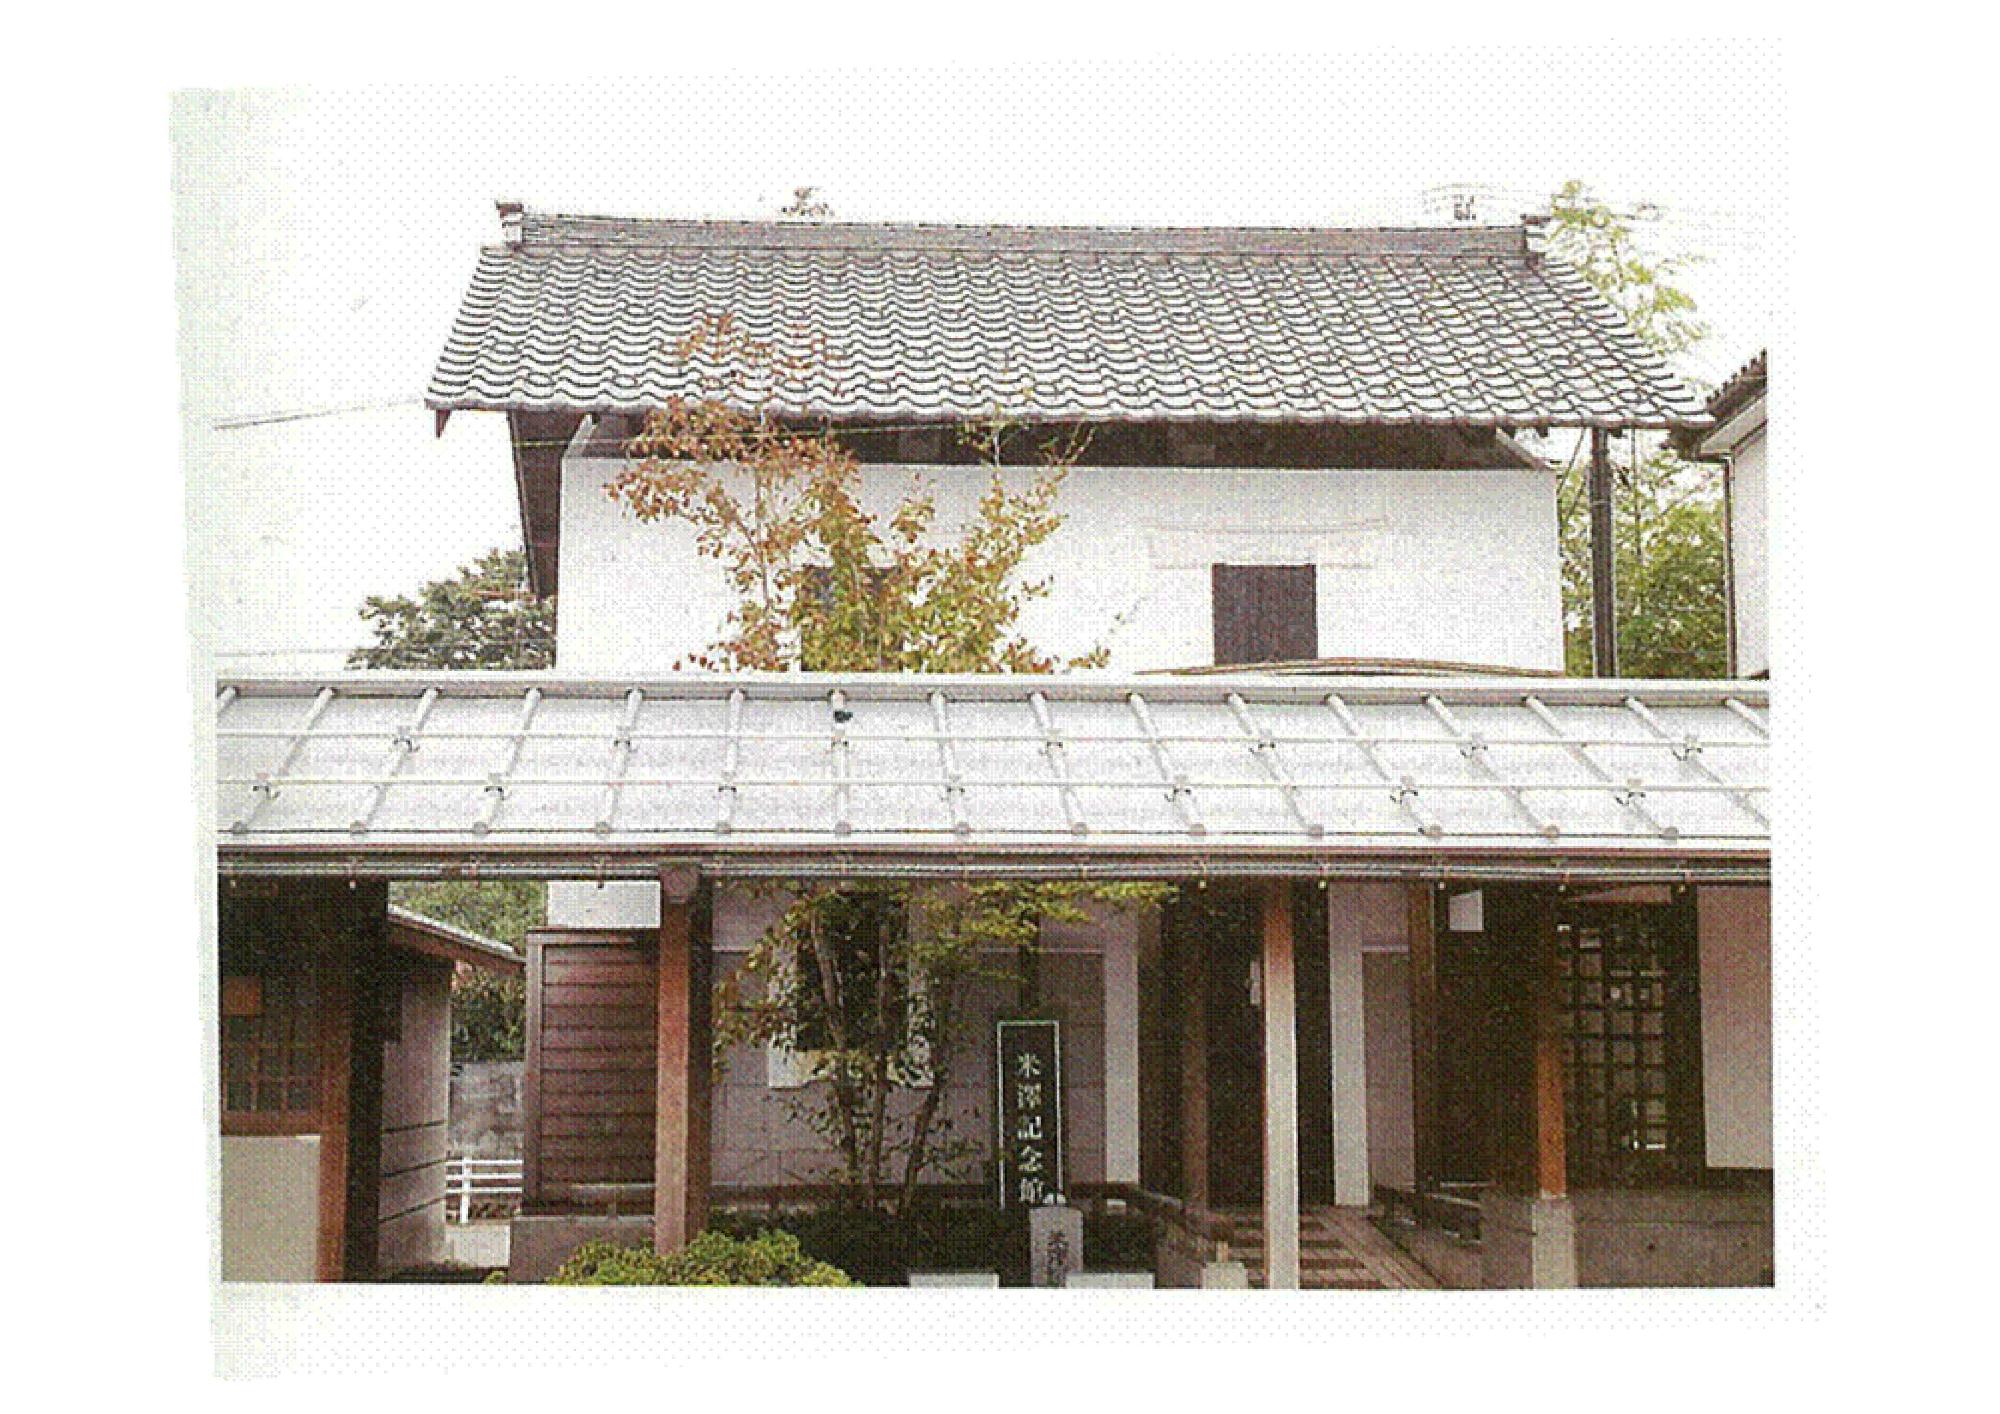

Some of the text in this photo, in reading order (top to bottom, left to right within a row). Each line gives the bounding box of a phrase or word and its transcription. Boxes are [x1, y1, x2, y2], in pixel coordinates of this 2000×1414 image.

[1017, 1053, 1043, 1203] 米澤記念館
